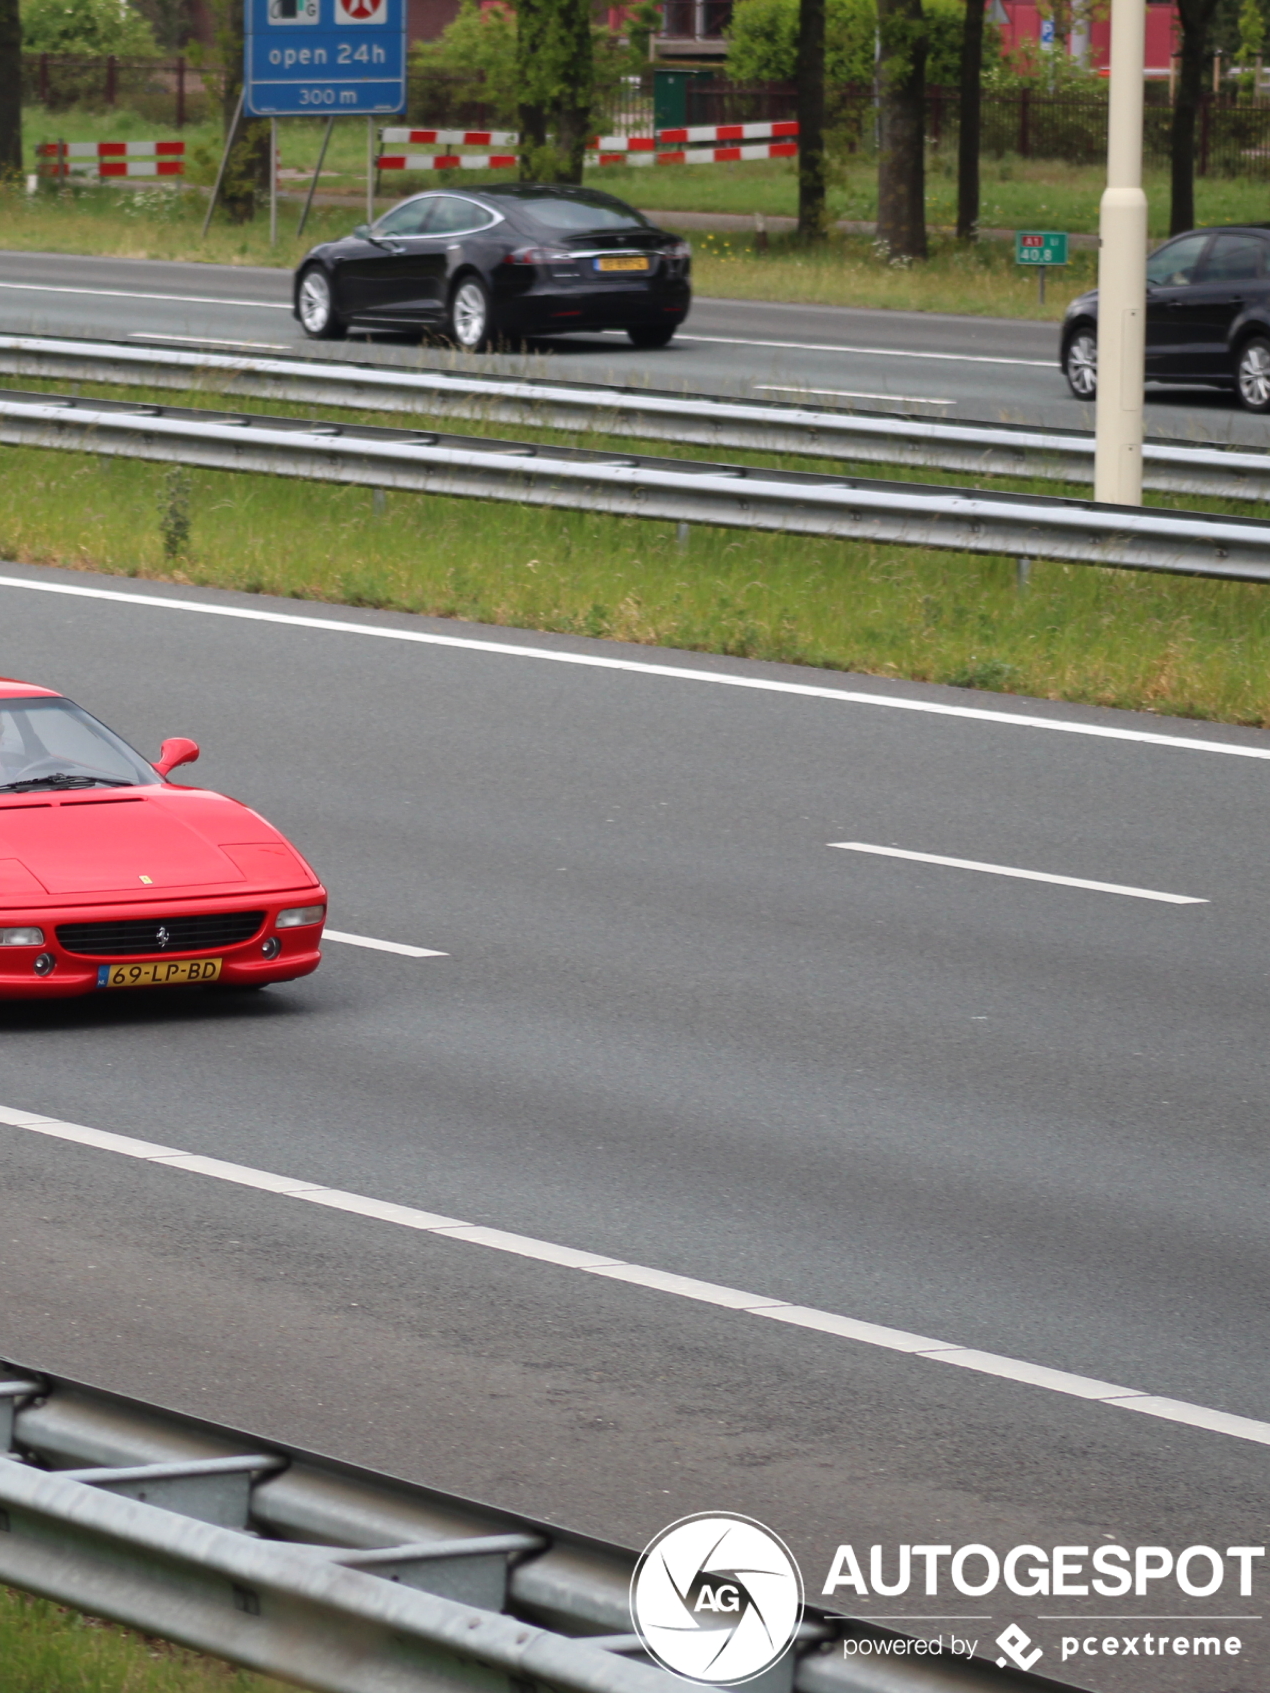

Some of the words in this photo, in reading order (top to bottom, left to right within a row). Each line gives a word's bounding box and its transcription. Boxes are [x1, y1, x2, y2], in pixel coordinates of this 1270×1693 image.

[268, 48, 327, 69] open
[337, 44, 386, 64] 24h
[298, 90, 335, 105] 300
[340, 91, 357, 104] m
[1024, 237, 1040, 246] A1
[112, 962, 217, 985] 69-LP-BD
